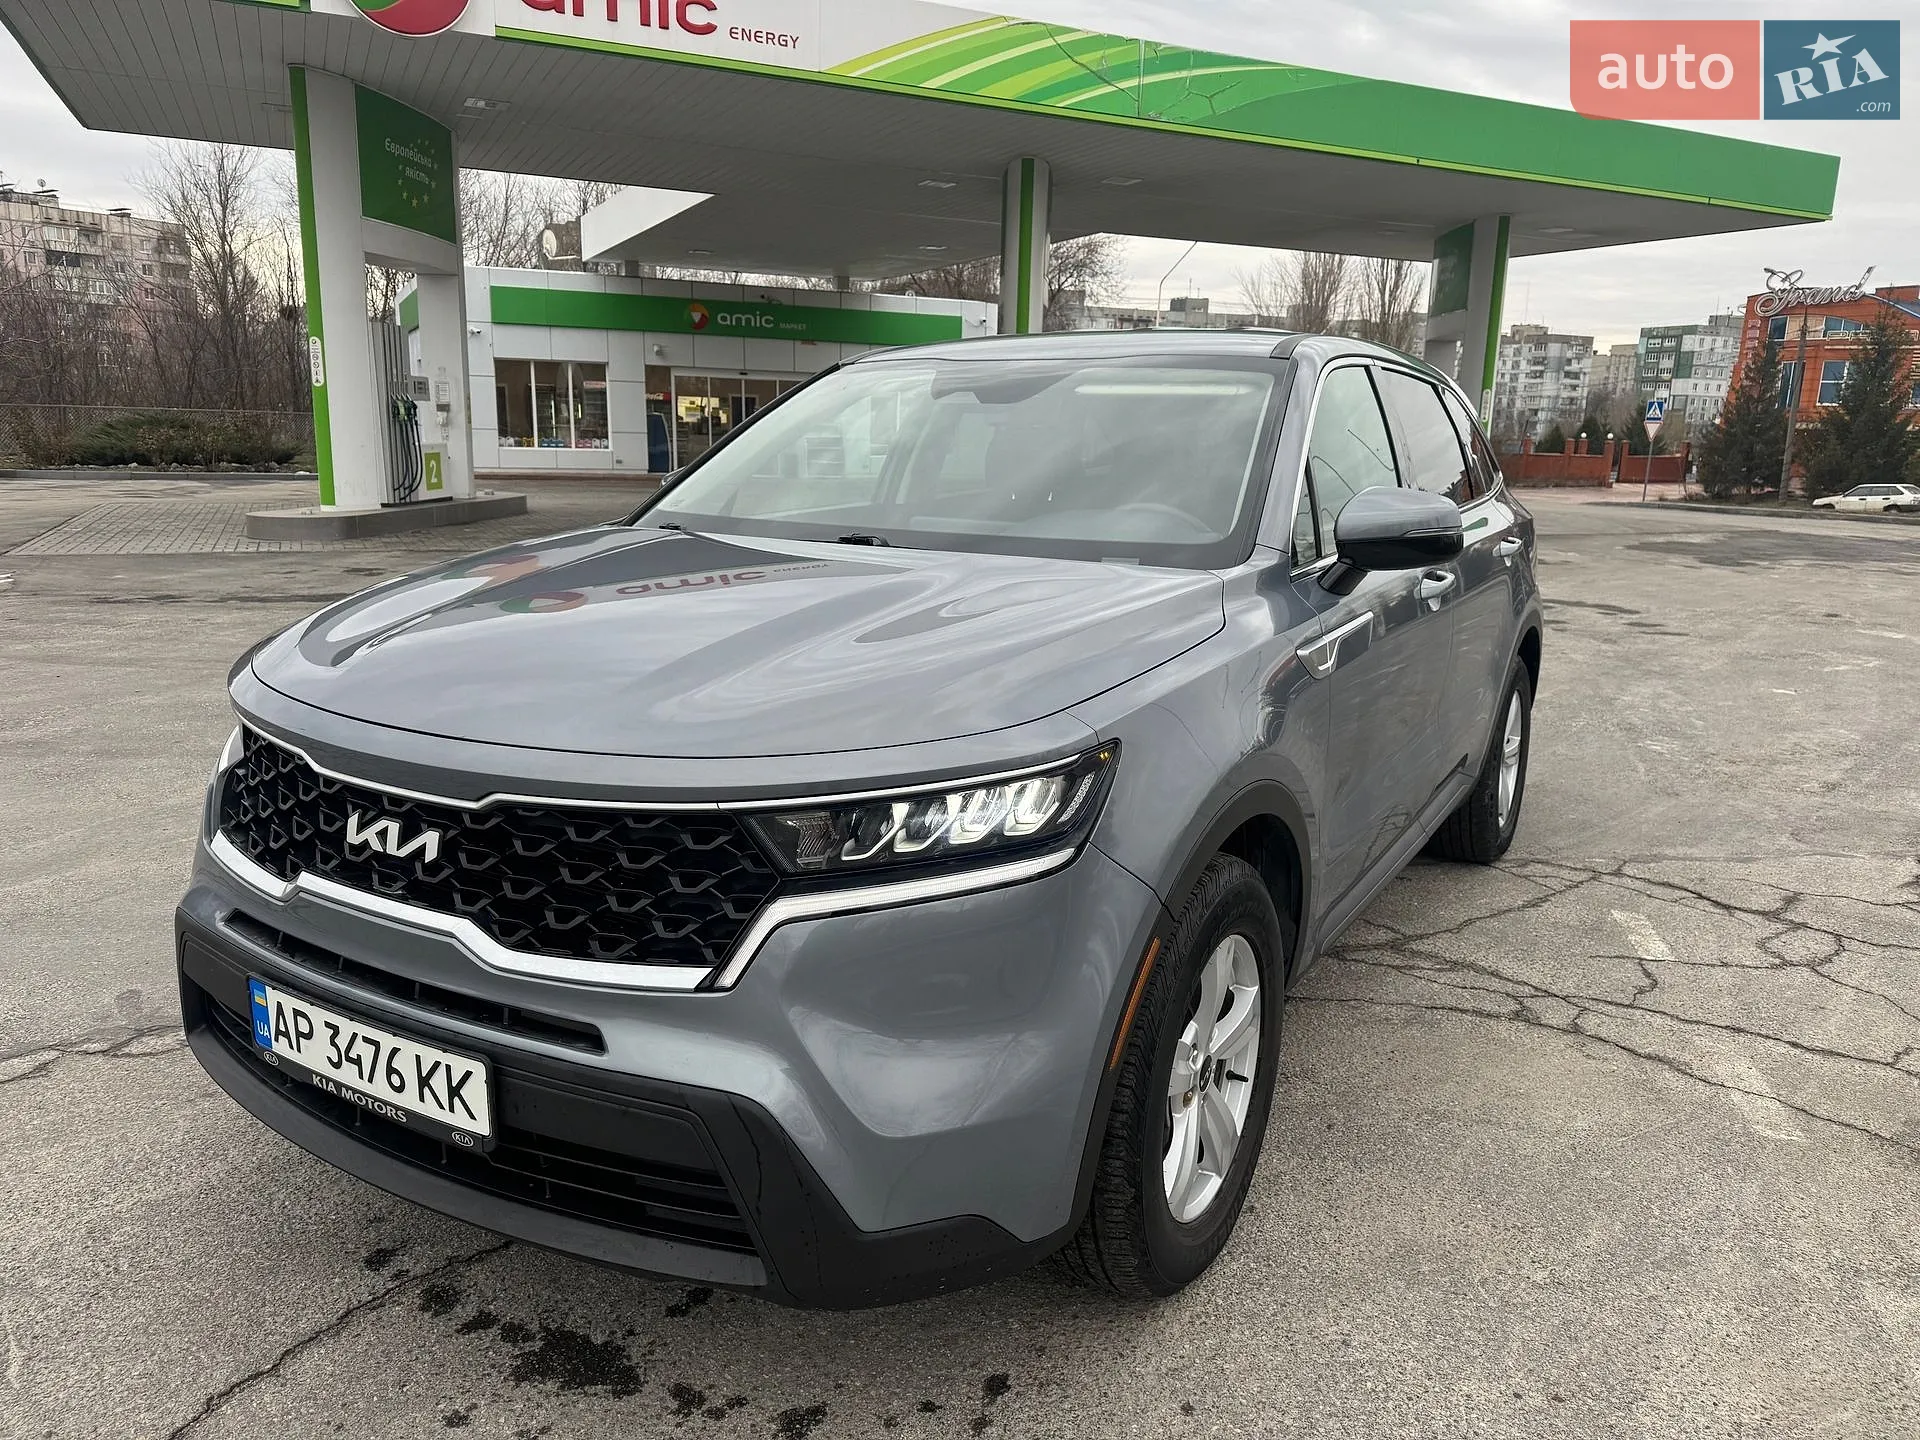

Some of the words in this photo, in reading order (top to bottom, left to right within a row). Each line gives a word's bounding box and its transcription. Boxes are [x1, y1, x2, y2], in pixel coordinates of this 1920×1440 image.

[520, 0, 718, 35] ic
[729, 26, 800, 49] ENERGY
[384, 137, 432, 168] Європейська
[1754, 265, 1877, 317] Grand
[717, 311, 775, 328] amic
[429, 459, 438, 483] 2
[347, 812, 440, 864] KIA
[257, 1021, 270, 1040] UA
[265, 1052, 277, 1065] KIA
[273, 1000, 314, 1054] AP
[324, 1020, 406, 1094] 3476
[415, 1054, 477, 1121] KK
[312, 1073, 337, 1095] KIA
[341, 1089, 407, 1124] MOTORS
[454, 1133, 472, 1146] KIA
